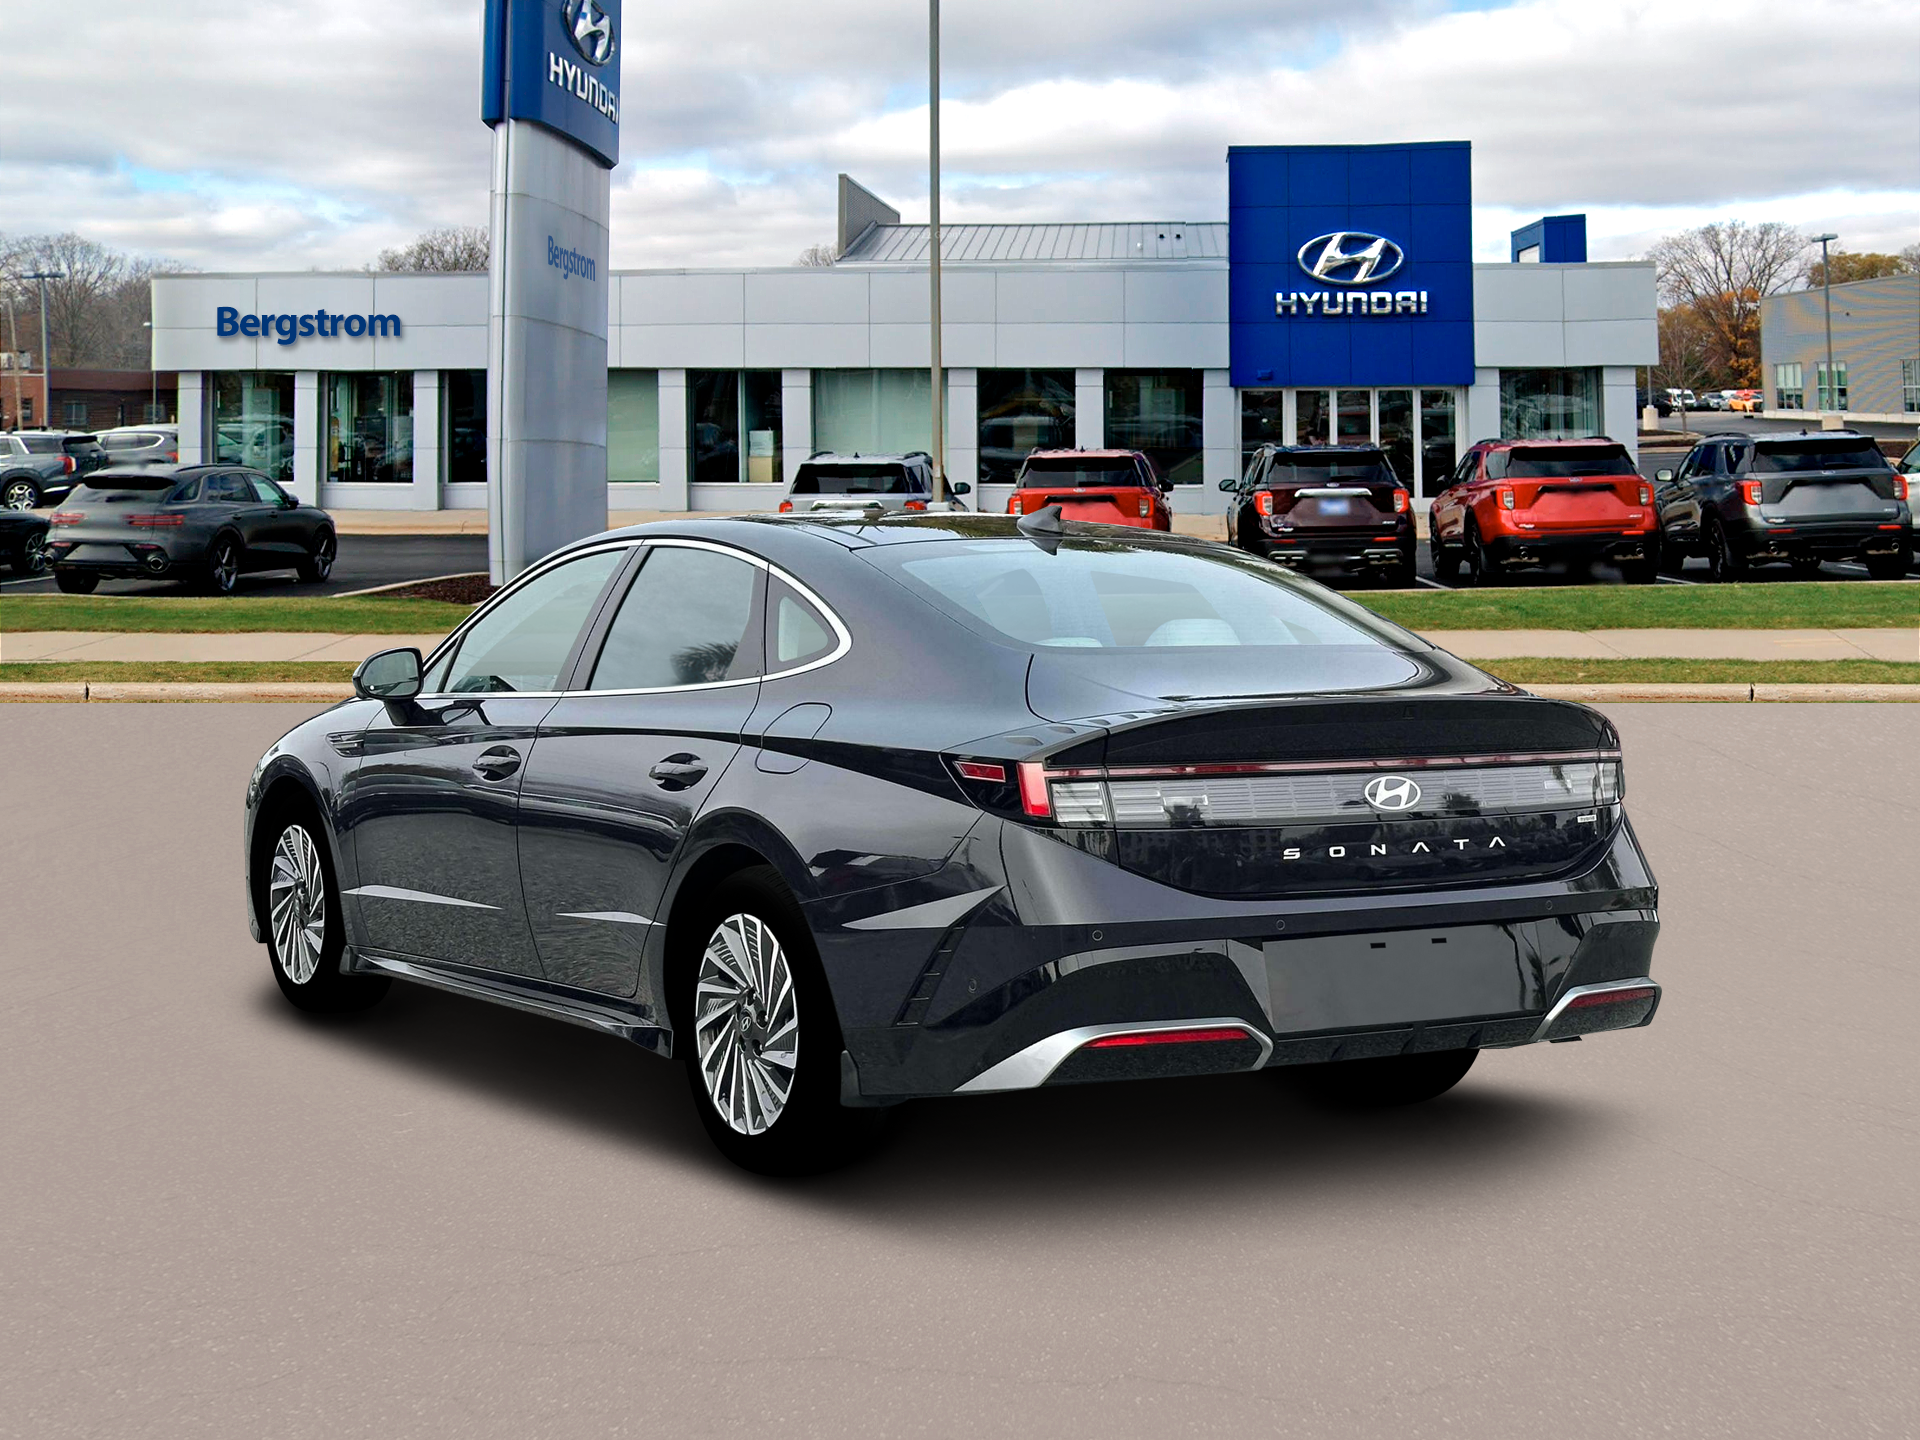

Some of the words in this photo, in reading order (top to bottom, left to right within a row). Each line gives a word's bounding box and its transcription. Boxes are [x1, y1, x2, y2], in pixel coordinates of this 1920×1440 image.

[549, 52, 618, 124] HYUNDAI
[547, 235, 596, 281] Bergstrom
[1275, 291, 1428, 315] HYUNDAI
[217, 306, 401, 345] Bergstrom
[1282, 836, 1506, 860] SONATA
